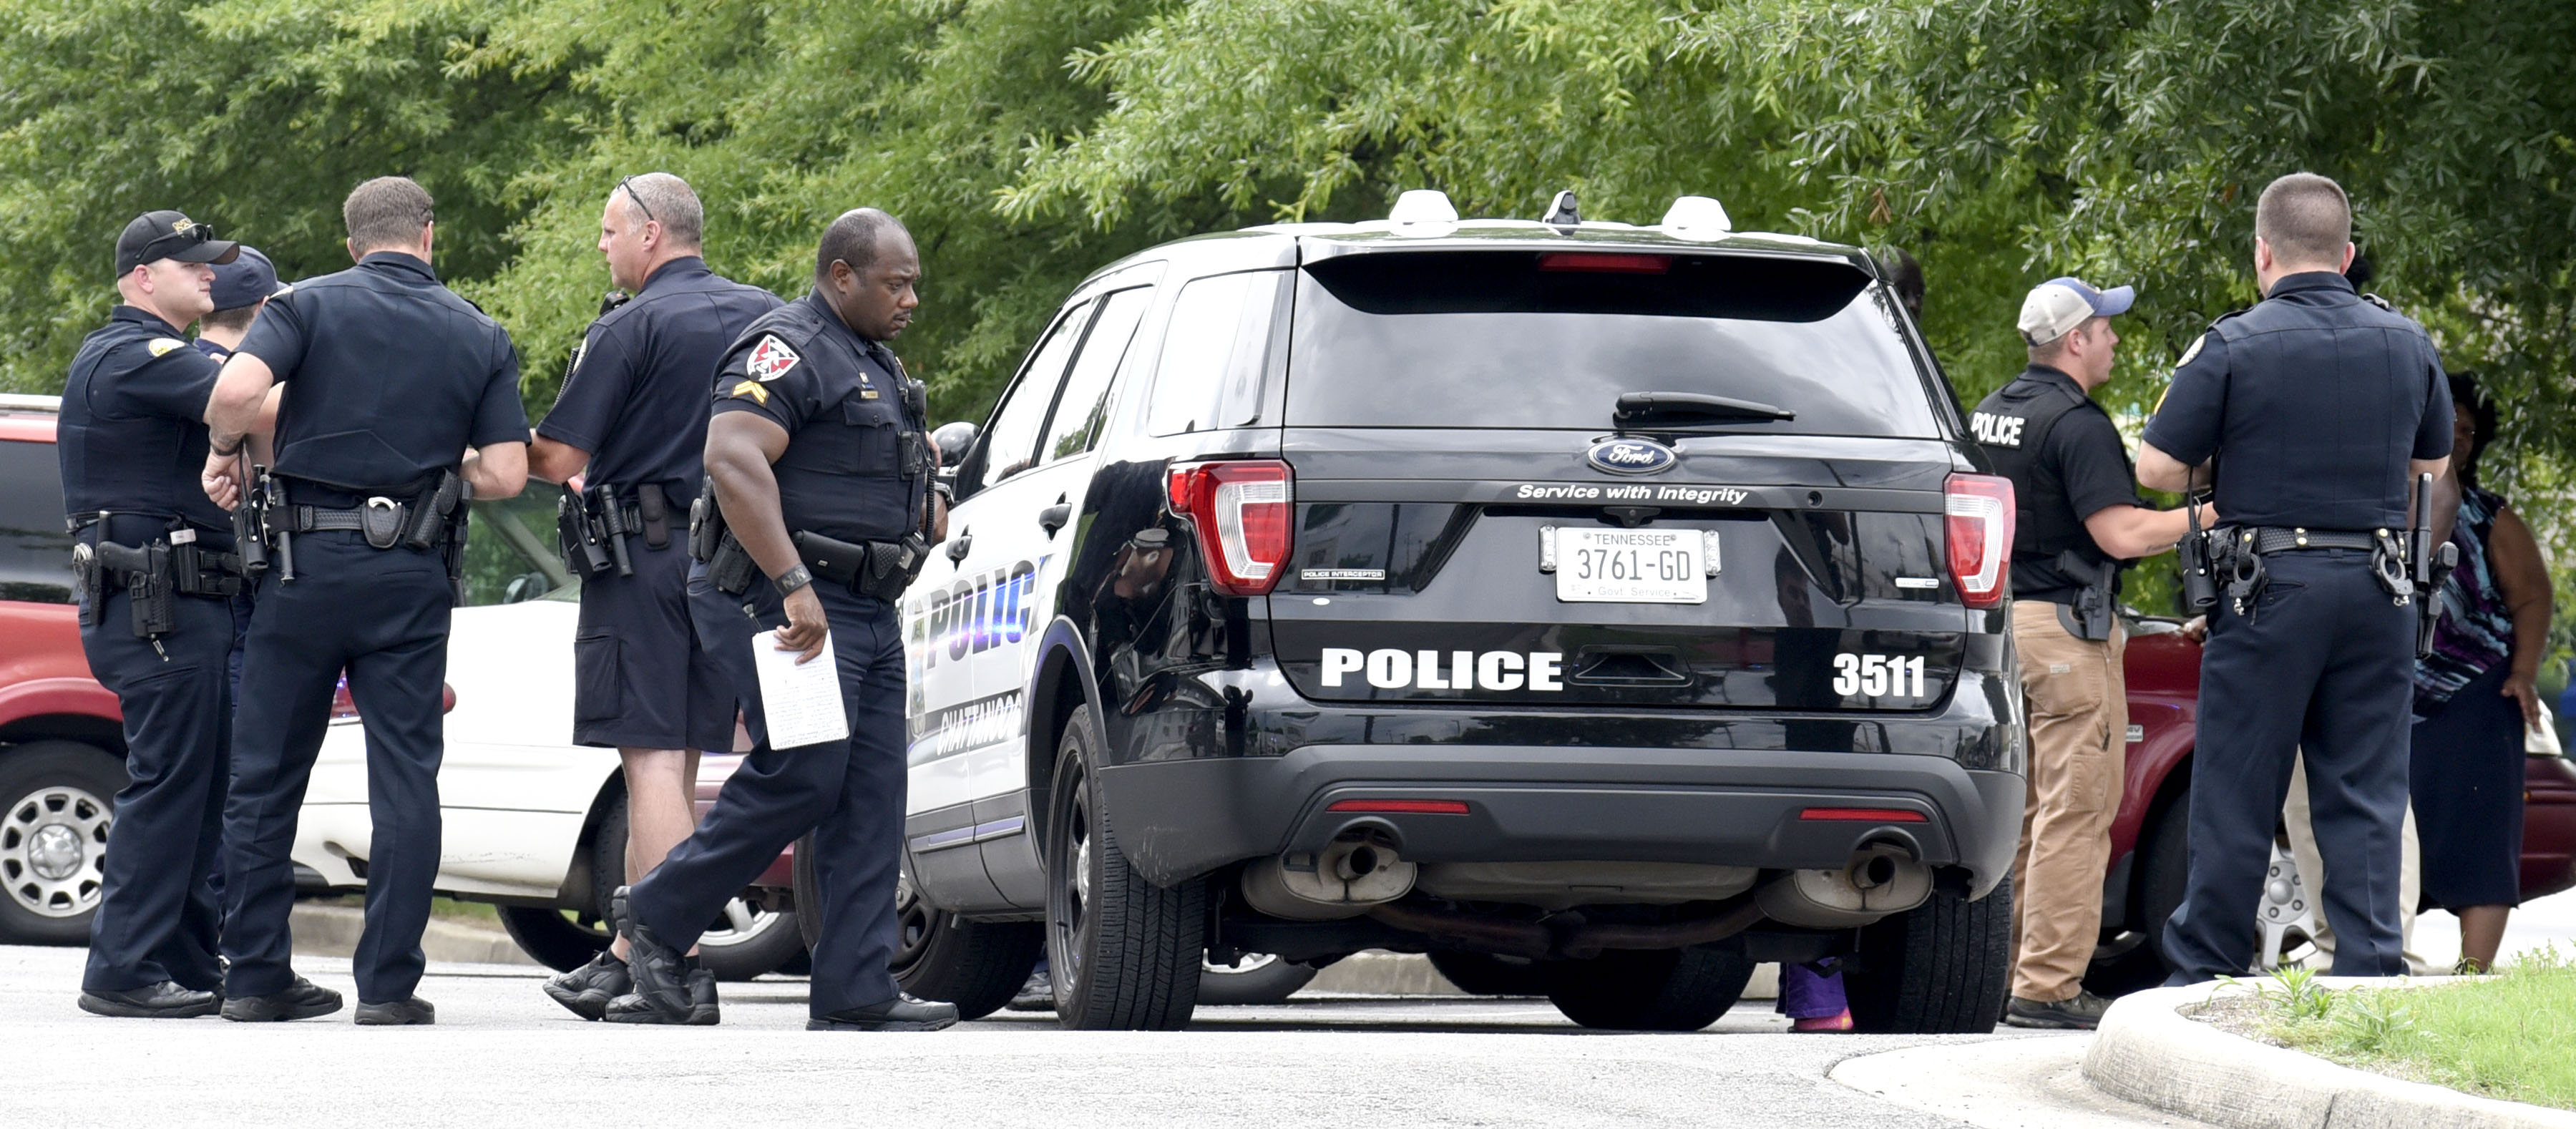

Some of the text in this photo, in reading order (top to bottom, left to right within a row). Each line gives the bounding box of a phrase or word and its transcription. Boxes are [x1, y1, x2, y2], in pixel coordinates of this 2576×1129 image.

[1971, 412, 2024, 446] POLICE
[1609, 444, 1654, 464] Ford
[1517, 484, 1747, 504] Service with Integrity
[1594, 534, 1671, 546] TENNESSEE
[1577, 549, 1691, 581] 3761-GD
[1631, 587, 1670, 596] Service
[1322, 648, 1563, 691] POLICE
[1833, 653, 1924, 697] 3511
